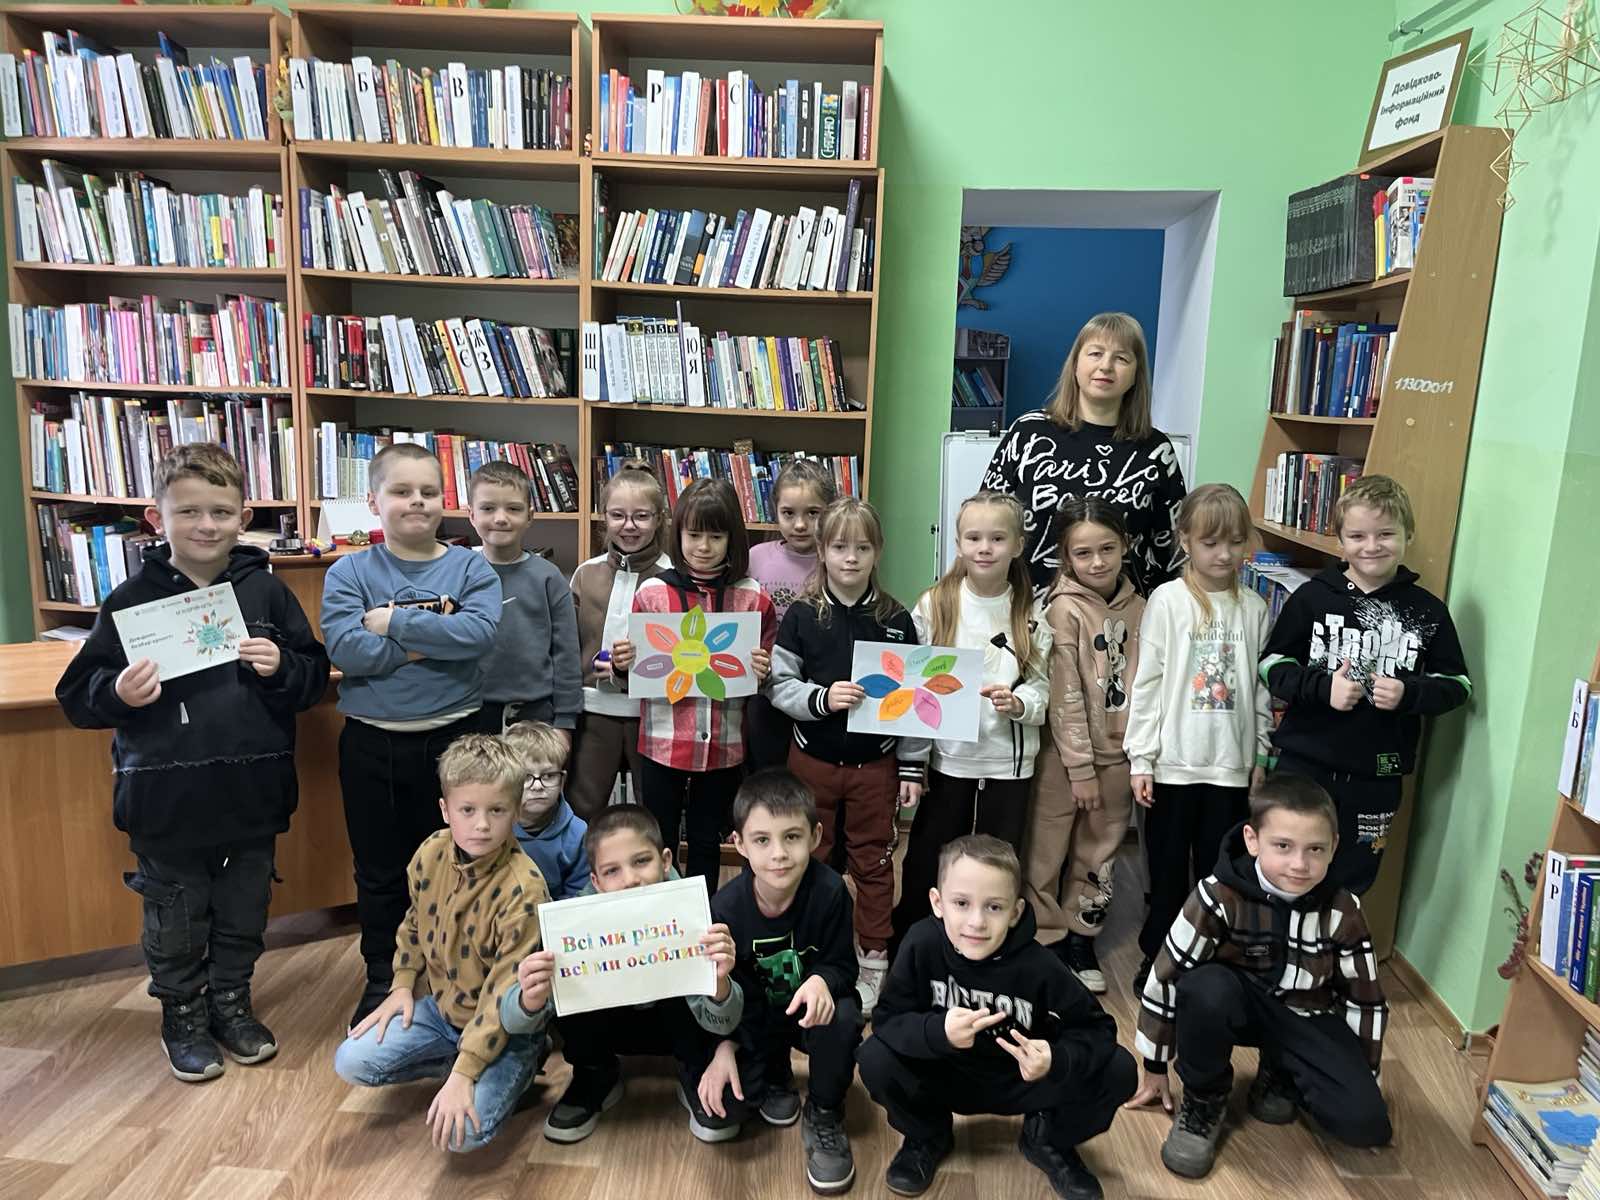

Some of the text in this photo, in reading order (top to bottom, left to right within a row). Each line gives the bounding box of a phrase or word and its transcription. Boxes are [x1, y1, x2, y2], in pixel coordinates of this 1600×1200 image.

[293, 68, 305, 90] А
[358, 72, 369, 92] Б
[452, 77, 464, 97] В
[650, 83, 662, 103] Р
[729, 83, 741, 104] С
[1394, 113, 1420, 130] фонд
[797, 219, 812, 240] У
[822, 217, 834, 238] Ф
[452, 328, 465, 346] Е
[469, 329, 486, 348] Ж
[584, 333, 597, 350] Ш
[686, 336, 699, 354] Ю
[478, 351, 491, 370] З
[584, 354, 597, 372] Щ
[689, 359, 699, 374] Я
[1017, 433, 1110, 487] Paris
[1571, 711, 1581, 728] Б
[1551, 858, 1562, 877] П
[1550, 884, 1560, 900] Р
[561, 918, 686, 954] Всі ми різні,
[559, 943, 706, 979] всі ми особлив
